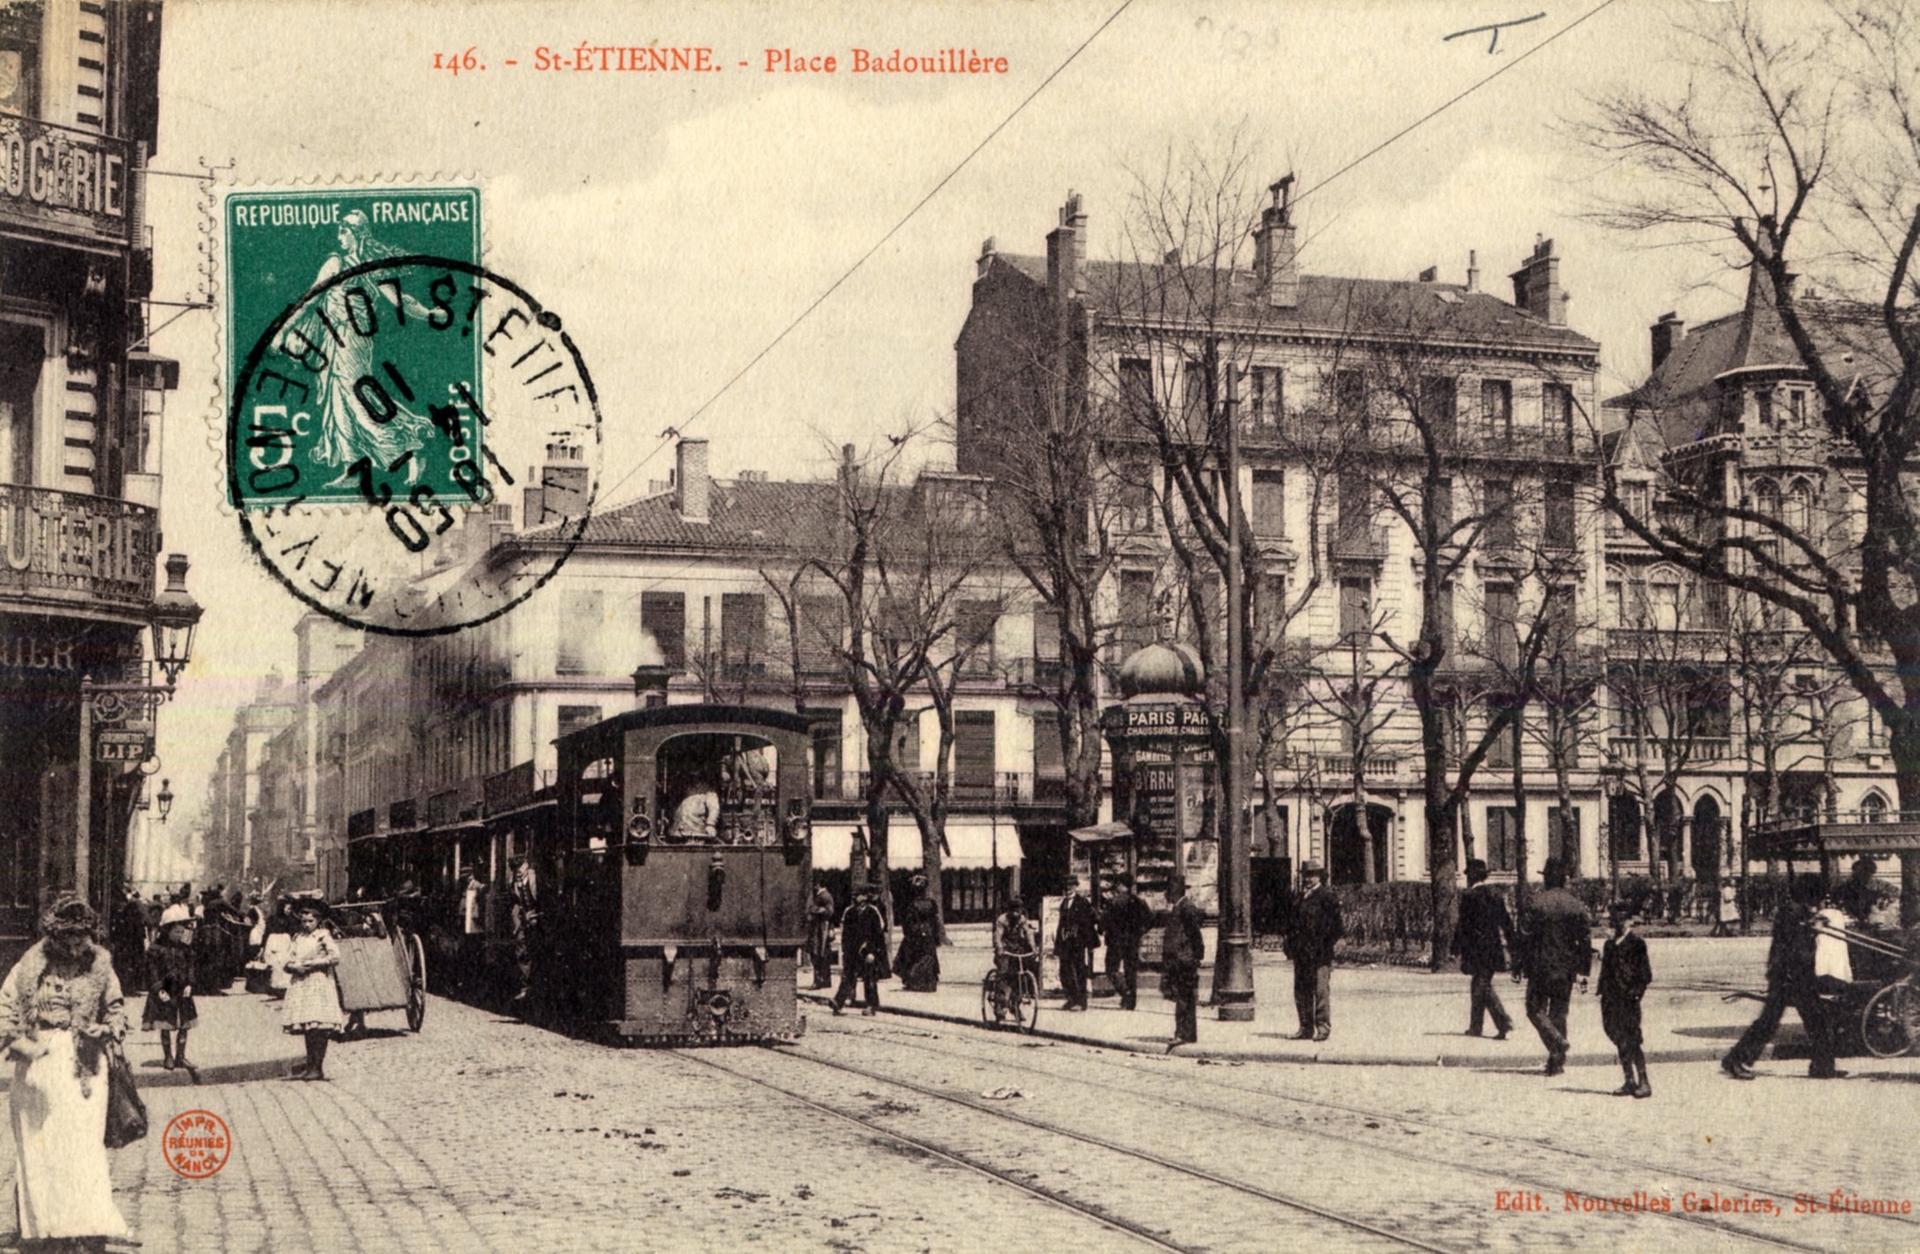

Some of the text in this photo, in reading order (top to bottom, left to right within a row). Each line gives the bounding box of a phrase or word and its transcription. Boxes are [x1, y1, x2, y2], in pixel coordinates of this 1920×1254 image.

[1129, 711, 1175, 726] PARIS
[103, 744, 144, 759] LIP
[1135, 771, 1175, 791] BYRRH
